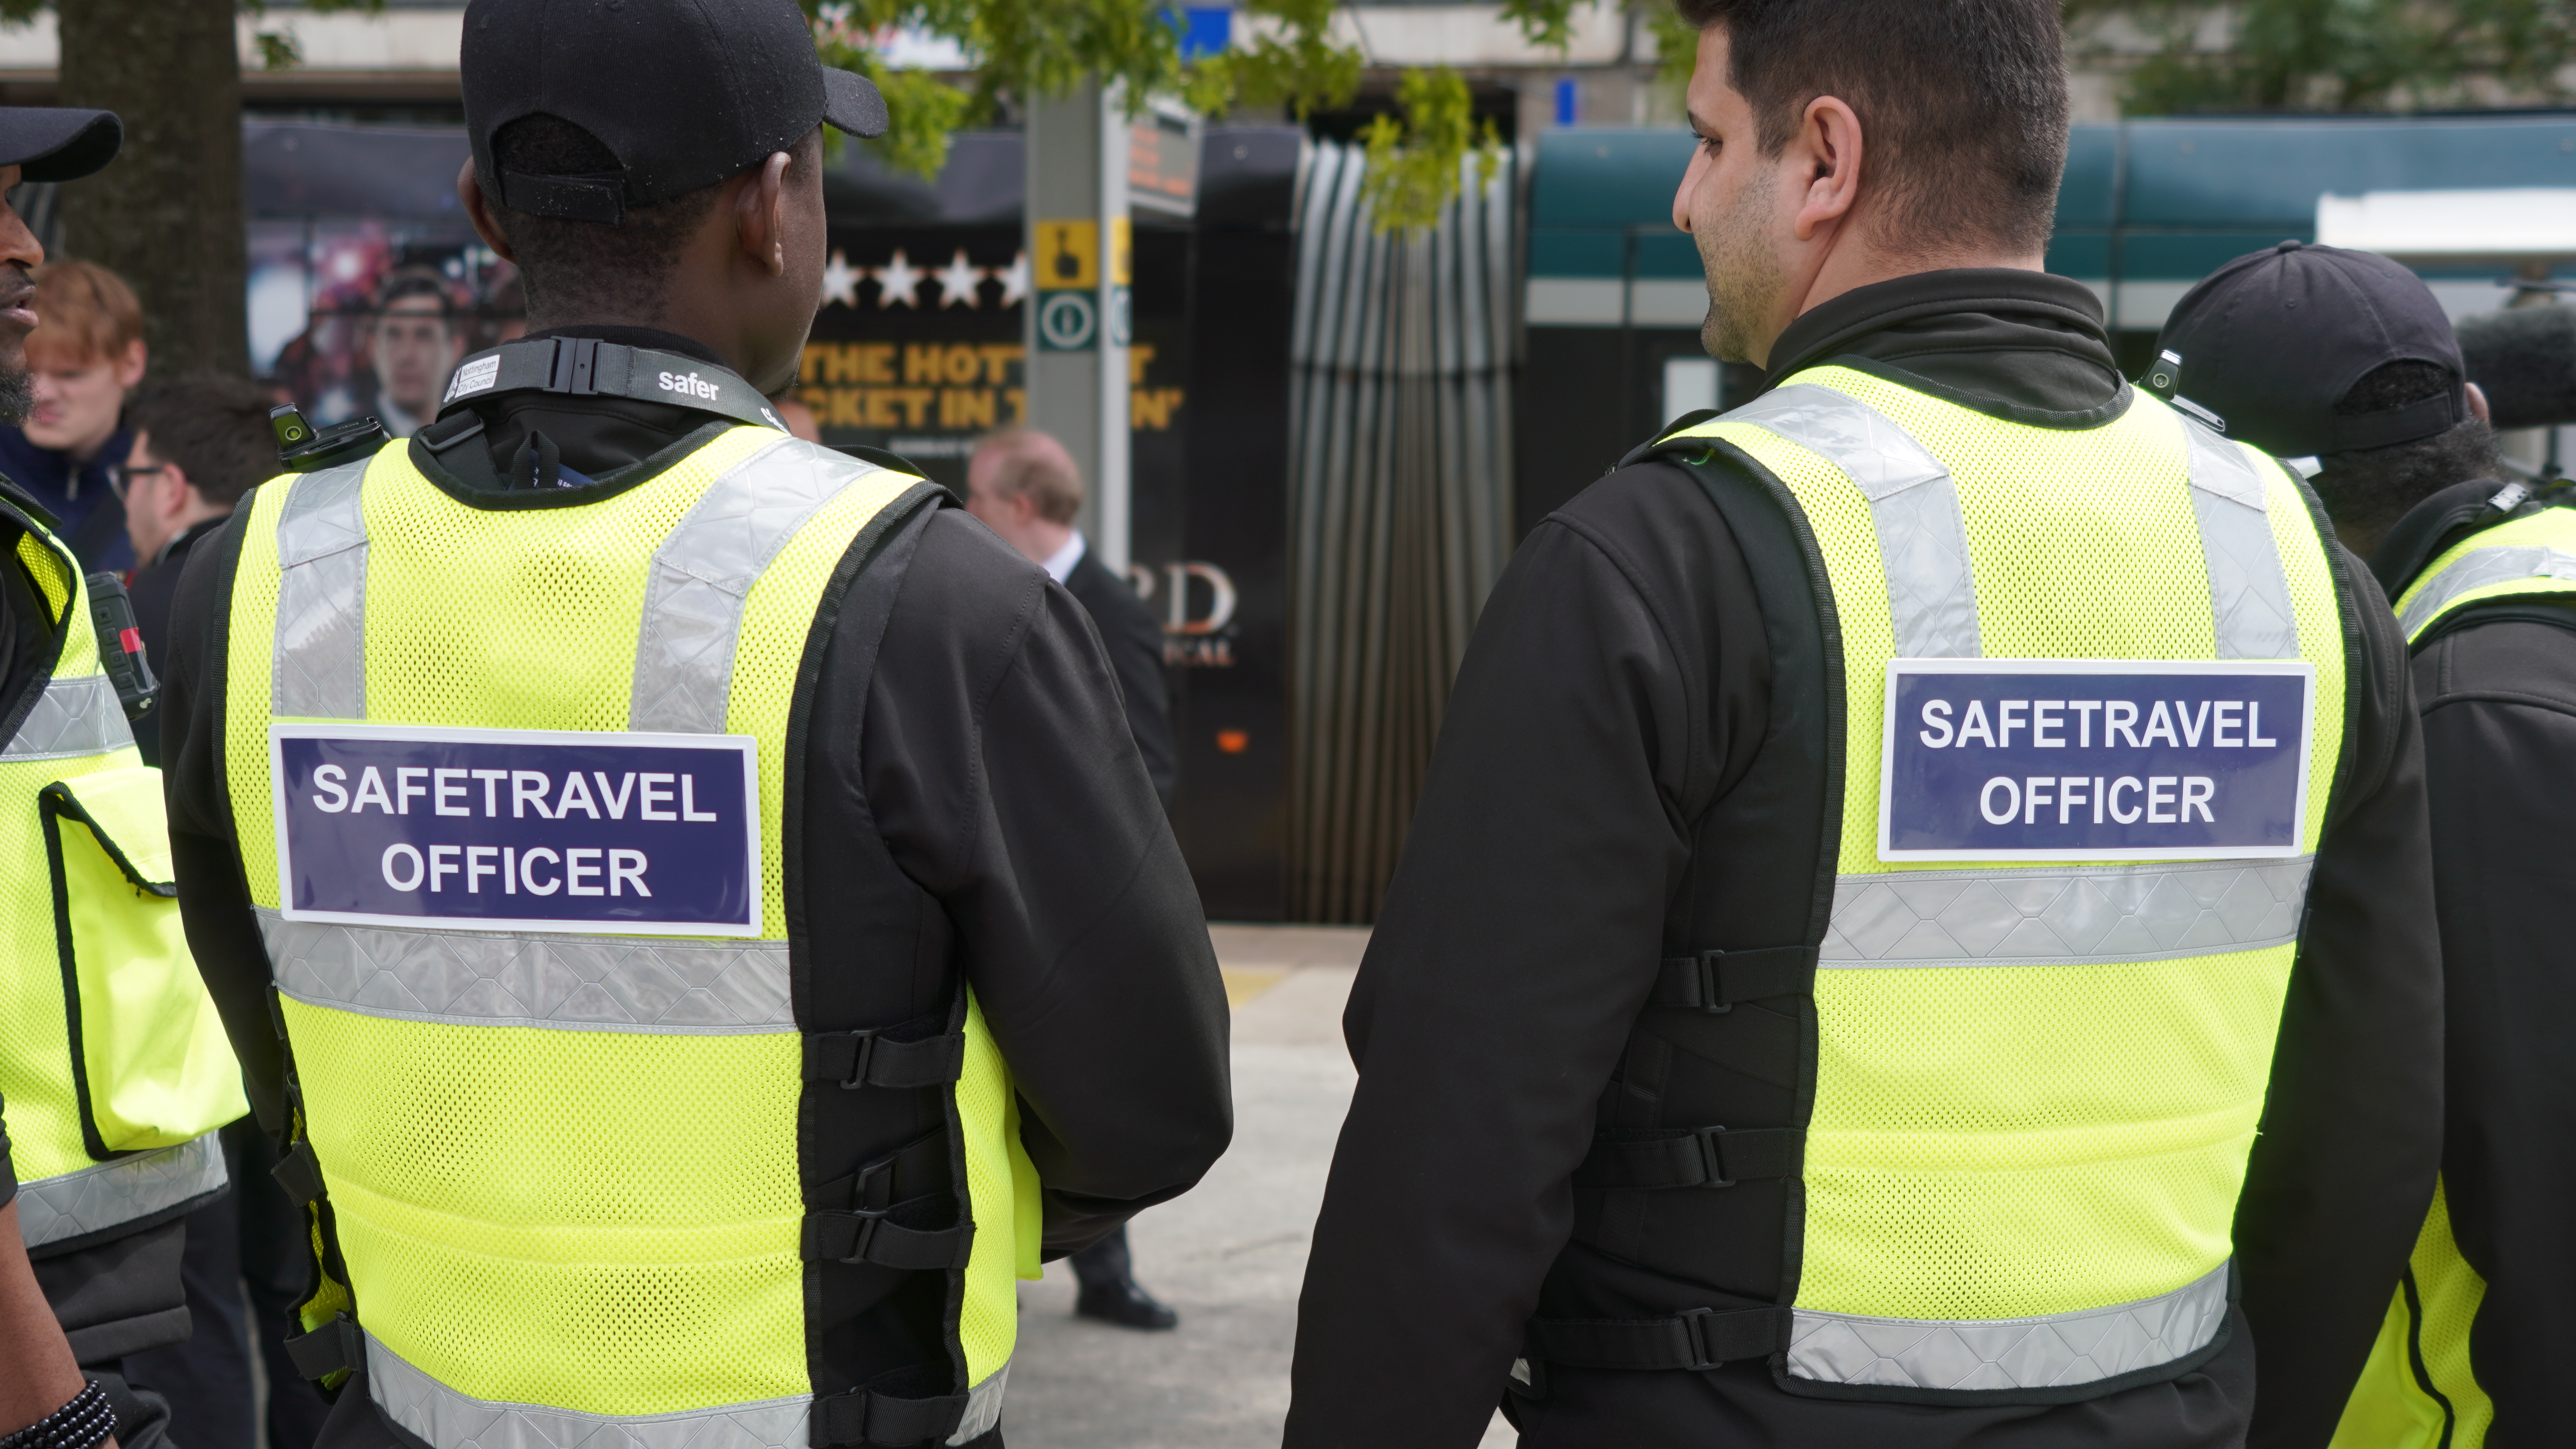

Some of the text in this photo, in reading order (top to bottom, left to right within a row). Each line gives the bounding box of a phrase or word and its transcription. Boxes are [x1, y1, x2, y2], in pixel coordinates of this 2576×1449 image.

[458, 375, 494, 393] City Council
[462, 361, 496, 378] Nottingham
[659, 372, 719, 401] safer
[939, 389, 995, 427] IN
[1920, 699, 2276, 749] SAFETRAVEL
[313, 764, 716, 822] SAFETRAVEL
[1980, 776, 2215, 825] OFFICER
[382, 843, 652, 897] OFFICER
